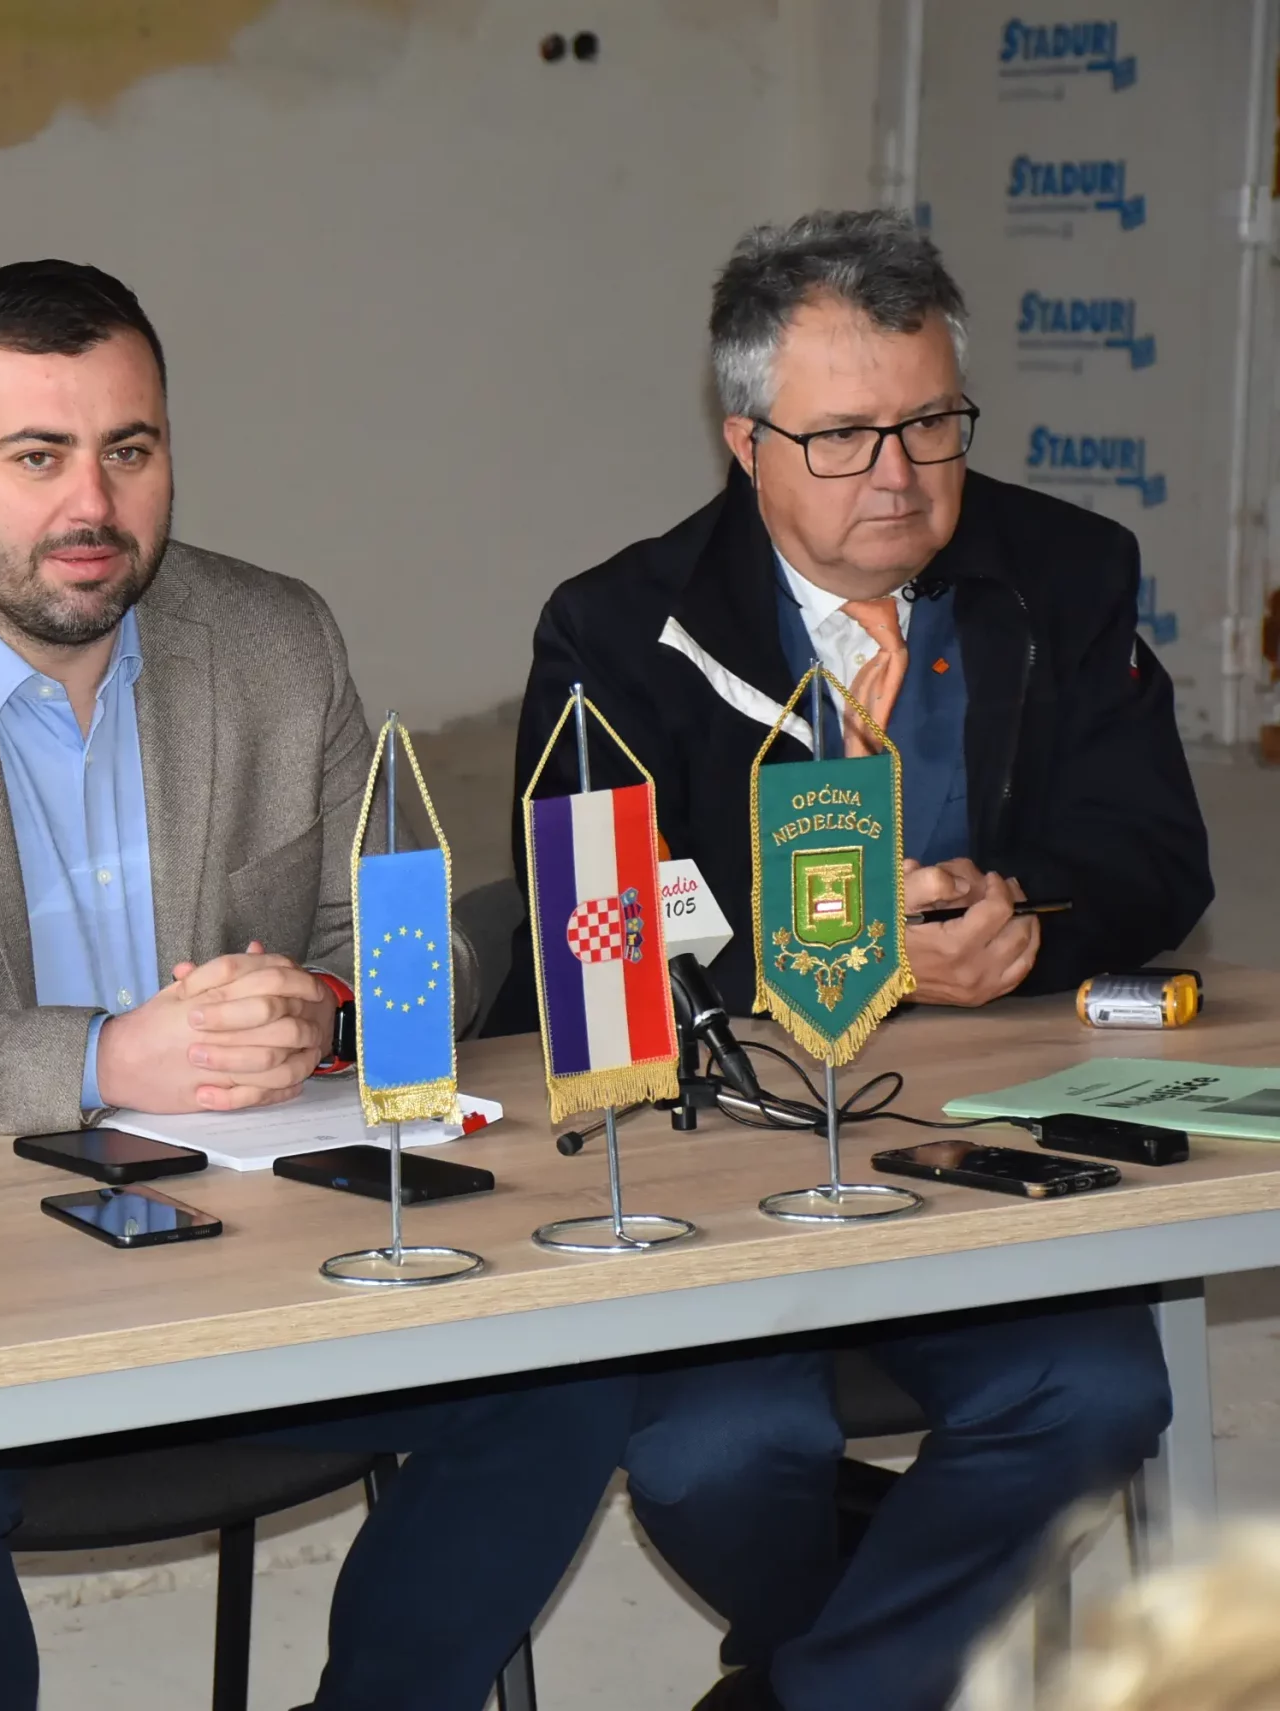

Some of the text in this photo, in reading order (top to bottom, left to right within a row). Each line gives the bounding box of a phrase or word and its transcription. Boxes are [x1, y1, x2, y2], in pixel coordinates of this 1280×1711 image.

[791, 783, 862, 809] OPĆINA
[771, 810, 883, 847] NEDELIŠĆE
[660, 875, 698, 900] adio
[665, 896, 697, 919] 105
